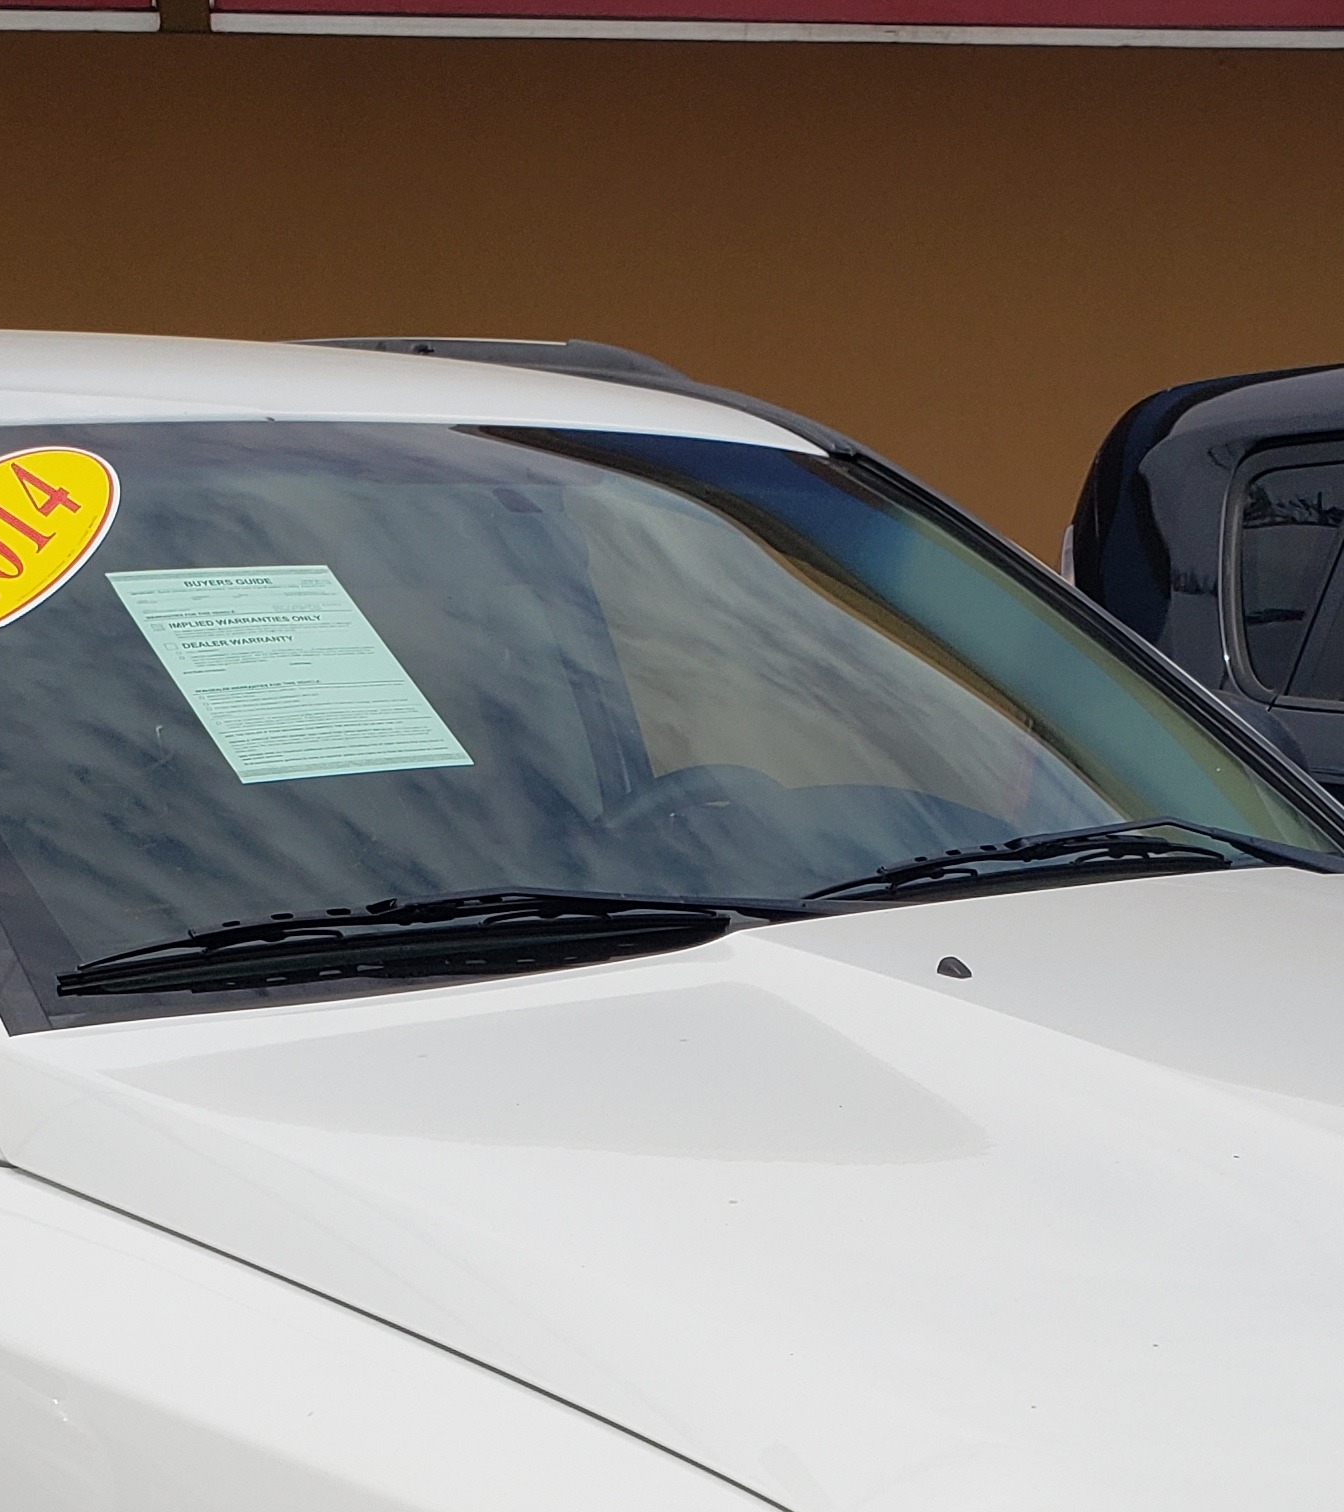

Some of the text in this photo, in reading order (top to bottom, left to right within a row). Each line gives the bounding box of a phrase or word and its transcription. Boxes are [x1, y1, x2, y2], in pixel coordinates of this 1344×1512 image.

[183, 577, 273, 588] BUYERS GUIDE
[168, 619, 214, 629] IMPLIED
[215, 614, 290, 627] WARRANTIES
[291, 613, 322, 622] ONLY
[181, 635, 293, 650] DEALER WARRANTY
